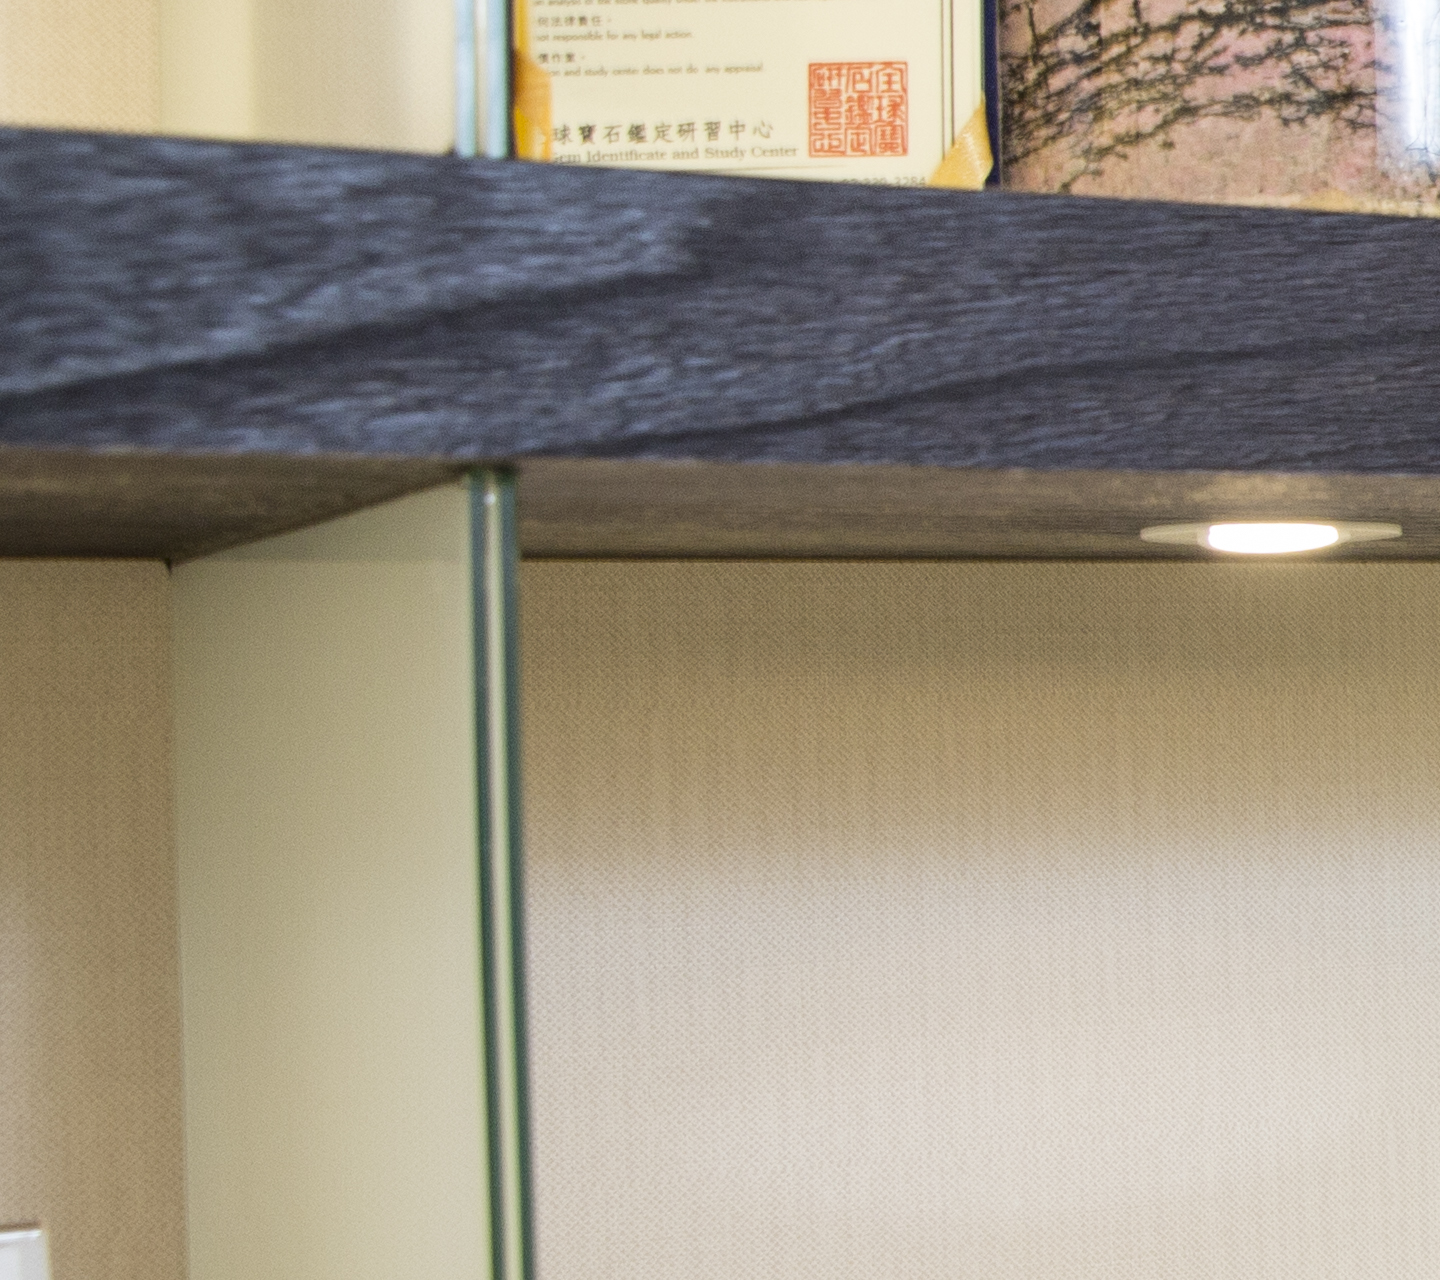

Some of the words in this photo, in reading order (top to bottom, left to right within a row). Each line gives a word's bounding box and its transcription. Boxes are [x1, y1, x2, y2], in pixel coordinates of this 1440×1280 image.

[672, 147, 700, 160] and
[704, 146, 748, 162] Study
[751, 145, 799, 159] Center
